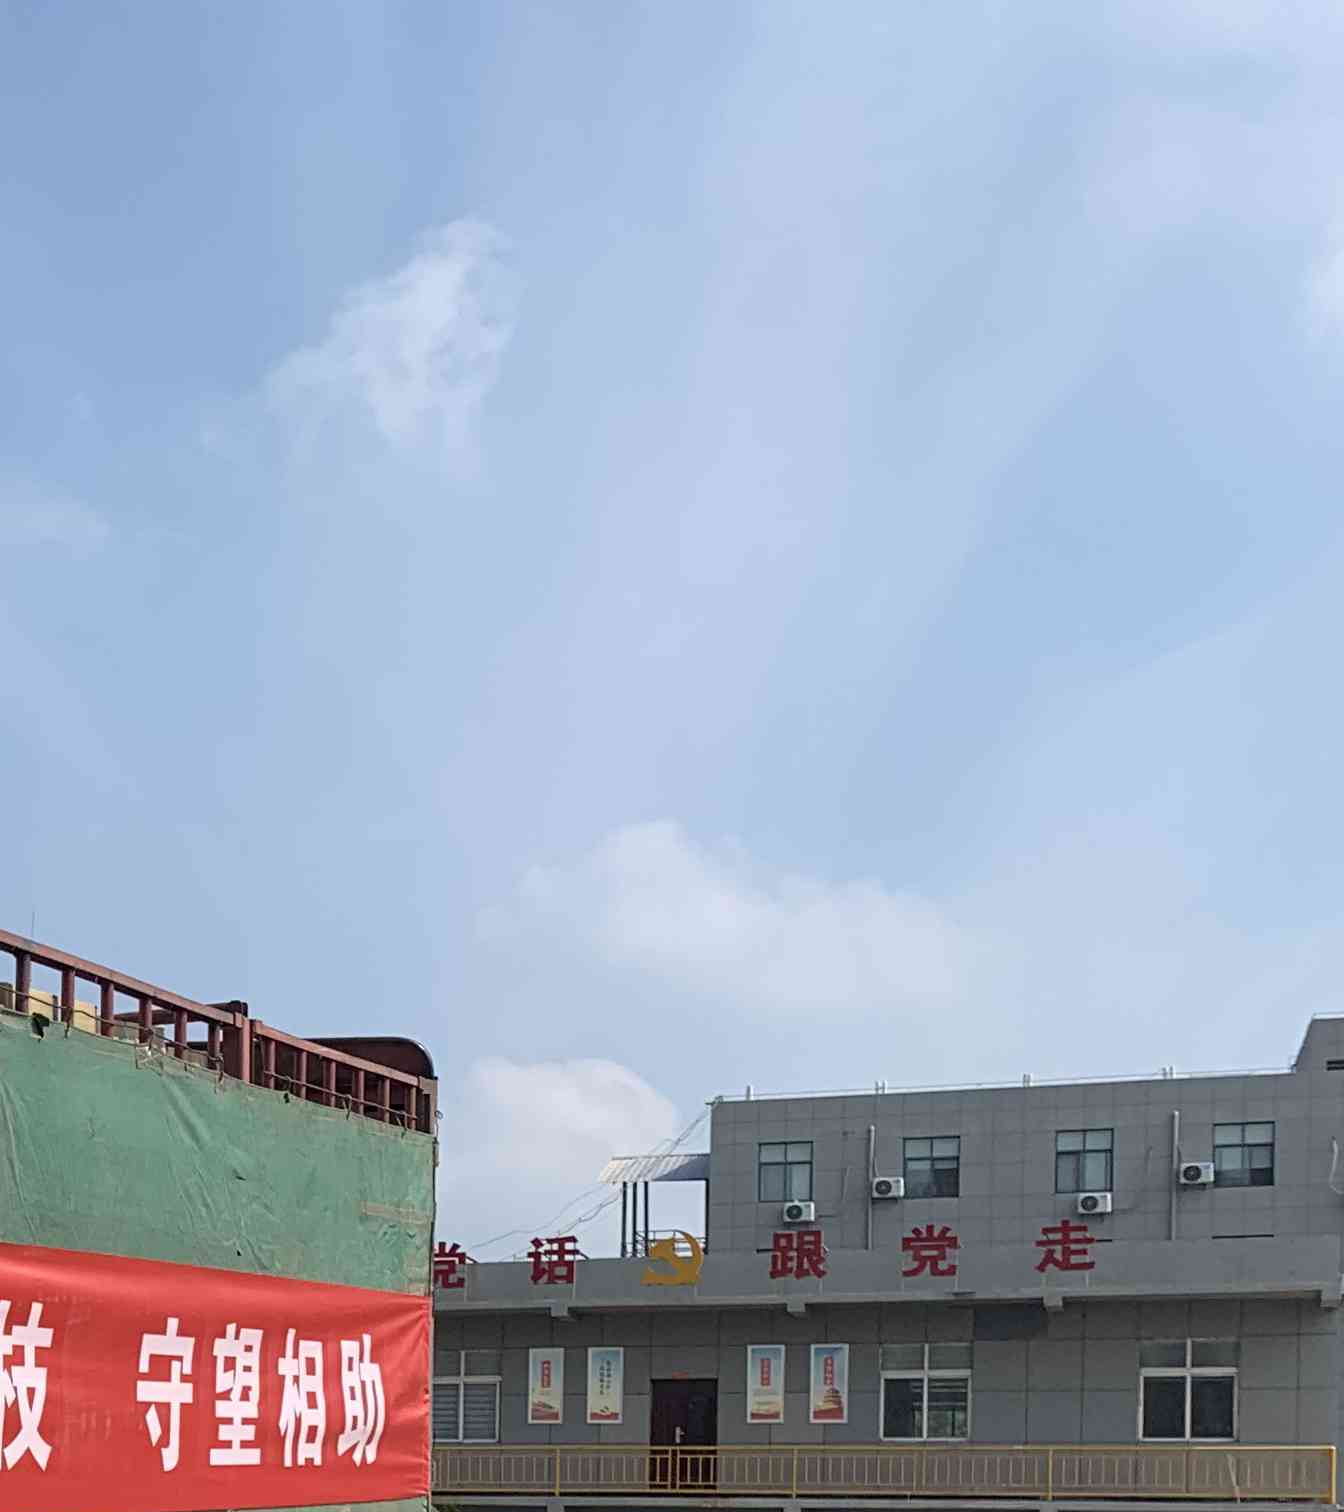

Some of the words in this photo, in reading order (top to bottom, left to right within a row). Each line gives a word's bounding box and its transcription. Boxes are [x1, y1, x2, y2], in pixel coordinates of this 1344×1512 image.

[768, 1219, 1096, 1281] 跟党走
[135, 1317, 386, 1472] 守望相助
